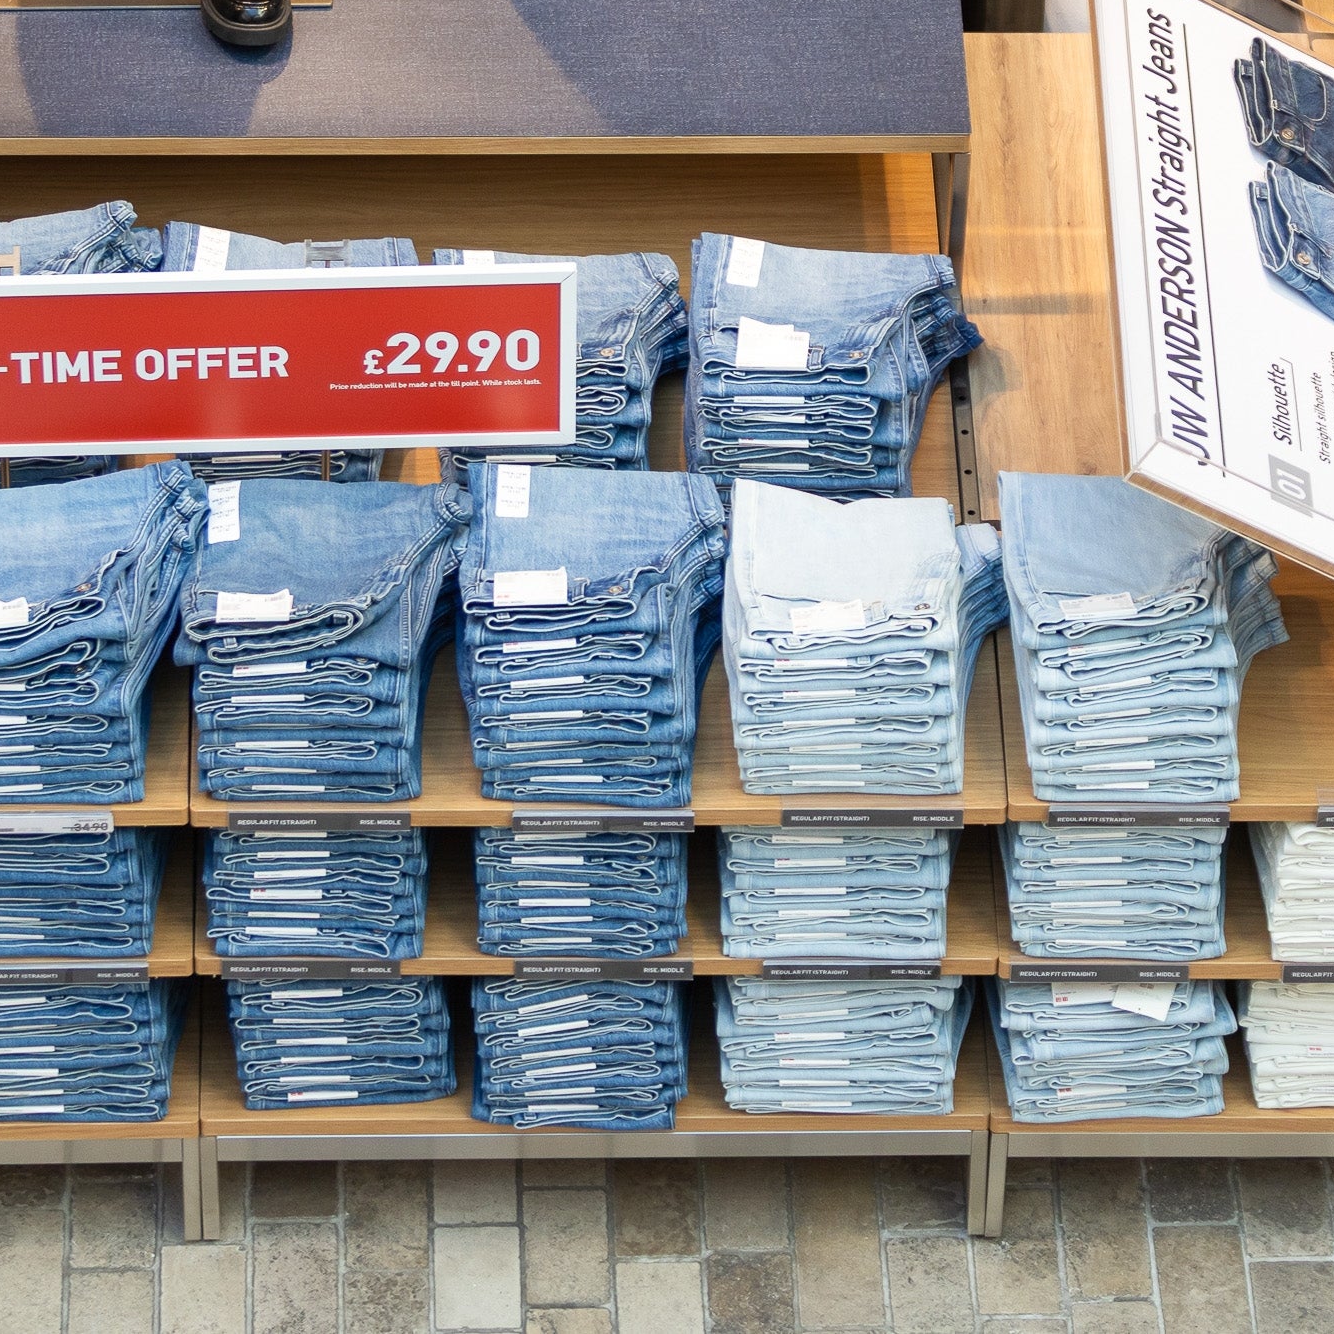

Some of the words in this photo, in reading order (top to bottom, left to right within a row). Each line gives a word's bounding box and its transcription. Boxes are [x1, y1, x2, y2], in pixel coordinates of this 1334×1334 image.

[1142, 8, 1178, 95] Jeans
[1147, 95, 1192, 215] Straight
[1158, 212, 1205, 401] ANDERSON
[135, 345, 290, 382] OFFER
[363, 328, 541, 376] £29.90
[350, 382, 384, 390] reduction
[461, 380, 481, 388] point.
[1267, 363, 1292, 446] Silhouette
[1310, 372, 1326, 421] silhouette
[1171, 388, 1211, 466] JW
[1316, 421, 1332, 465] Straight
[1276, 468, 1307, 501] 01
